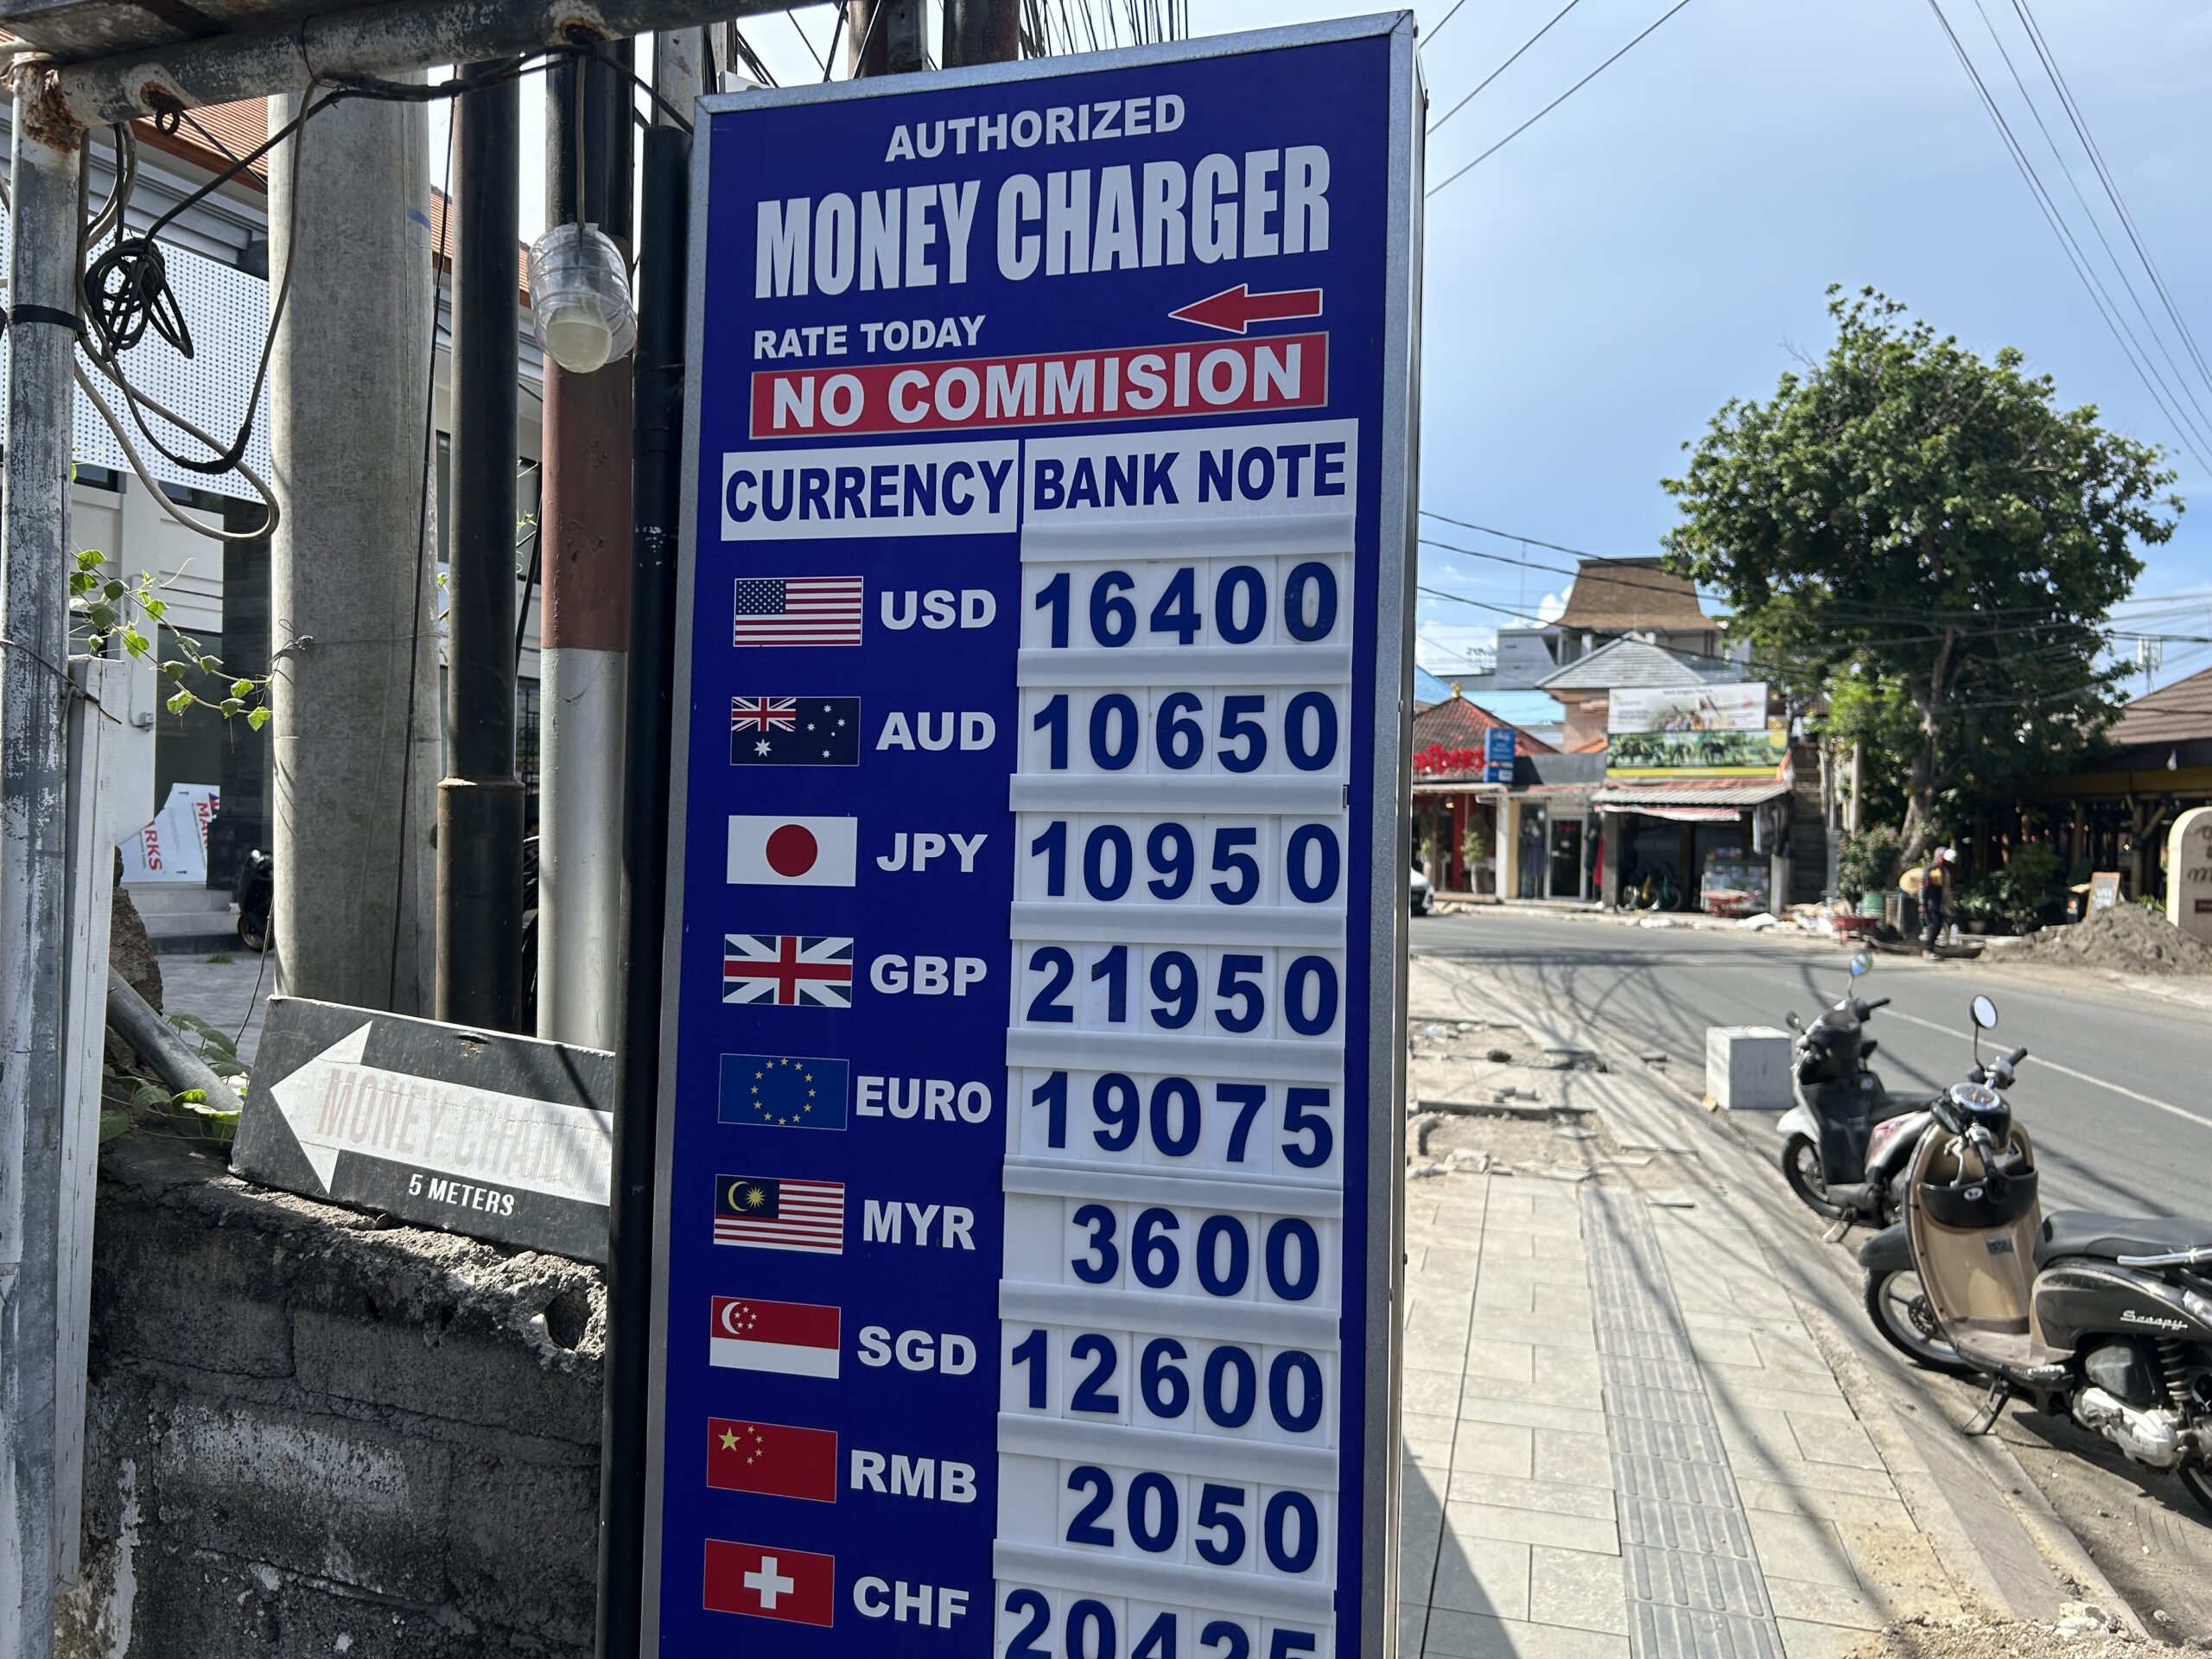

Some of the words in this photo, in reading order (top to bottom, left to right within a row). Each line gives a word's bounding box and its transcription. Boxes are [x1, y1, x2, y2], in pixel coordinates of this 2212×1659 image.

[885, 94, 1185, 162] AUTHORIZED
[756, 181, 980, 298] MONEY
[997, 145, 1331, 280] CHARGER
[754, 326, 847, 359] RATE
[861, 315, 985, 352] TODAY
[773, 374, 864, 429] NO
[888, 344, 1301, 424] COMMISION
[727, 460, 1014, 522] CURRENCY
[1034, 453, 1179, 510] BANK
[1198, 442, 1345, 502] NOTE
[881, 590, 995, 629] USD
[1036, 562, 1338, 648] 16400
[876, 712, 995, 750] AUD
[1034, 691, 1338, 772] 10650
[140, 820, 162, 871] RKS
[877, 833, 988, 872] JPY
[1032, 821, 1340, 905] 10950
[871, 955, 987, 995] GBP
[1027, 945, 1338, 1036] 21950
[317, 1069, 451, 1158] MONEY
[856, 1076, 991, 1122] EURO
[1033, 1071, 1332, 1168] 19075
[408, 1174, 423, 1196] 5
[429, 1178, 515, 1217] METERS
[864, 1200, 975, 1249] MYR
[1071, 1204, 1319, 1300] 3600
[858, 1326, 976, 1375] SGD
[1012, 1329, 1323, 1433] 12600
[851, 1450, 976, 1503] RMB
[1066, 1465, 1319, 1573] 2050
[854, 1577, 969, 1628] CHF
